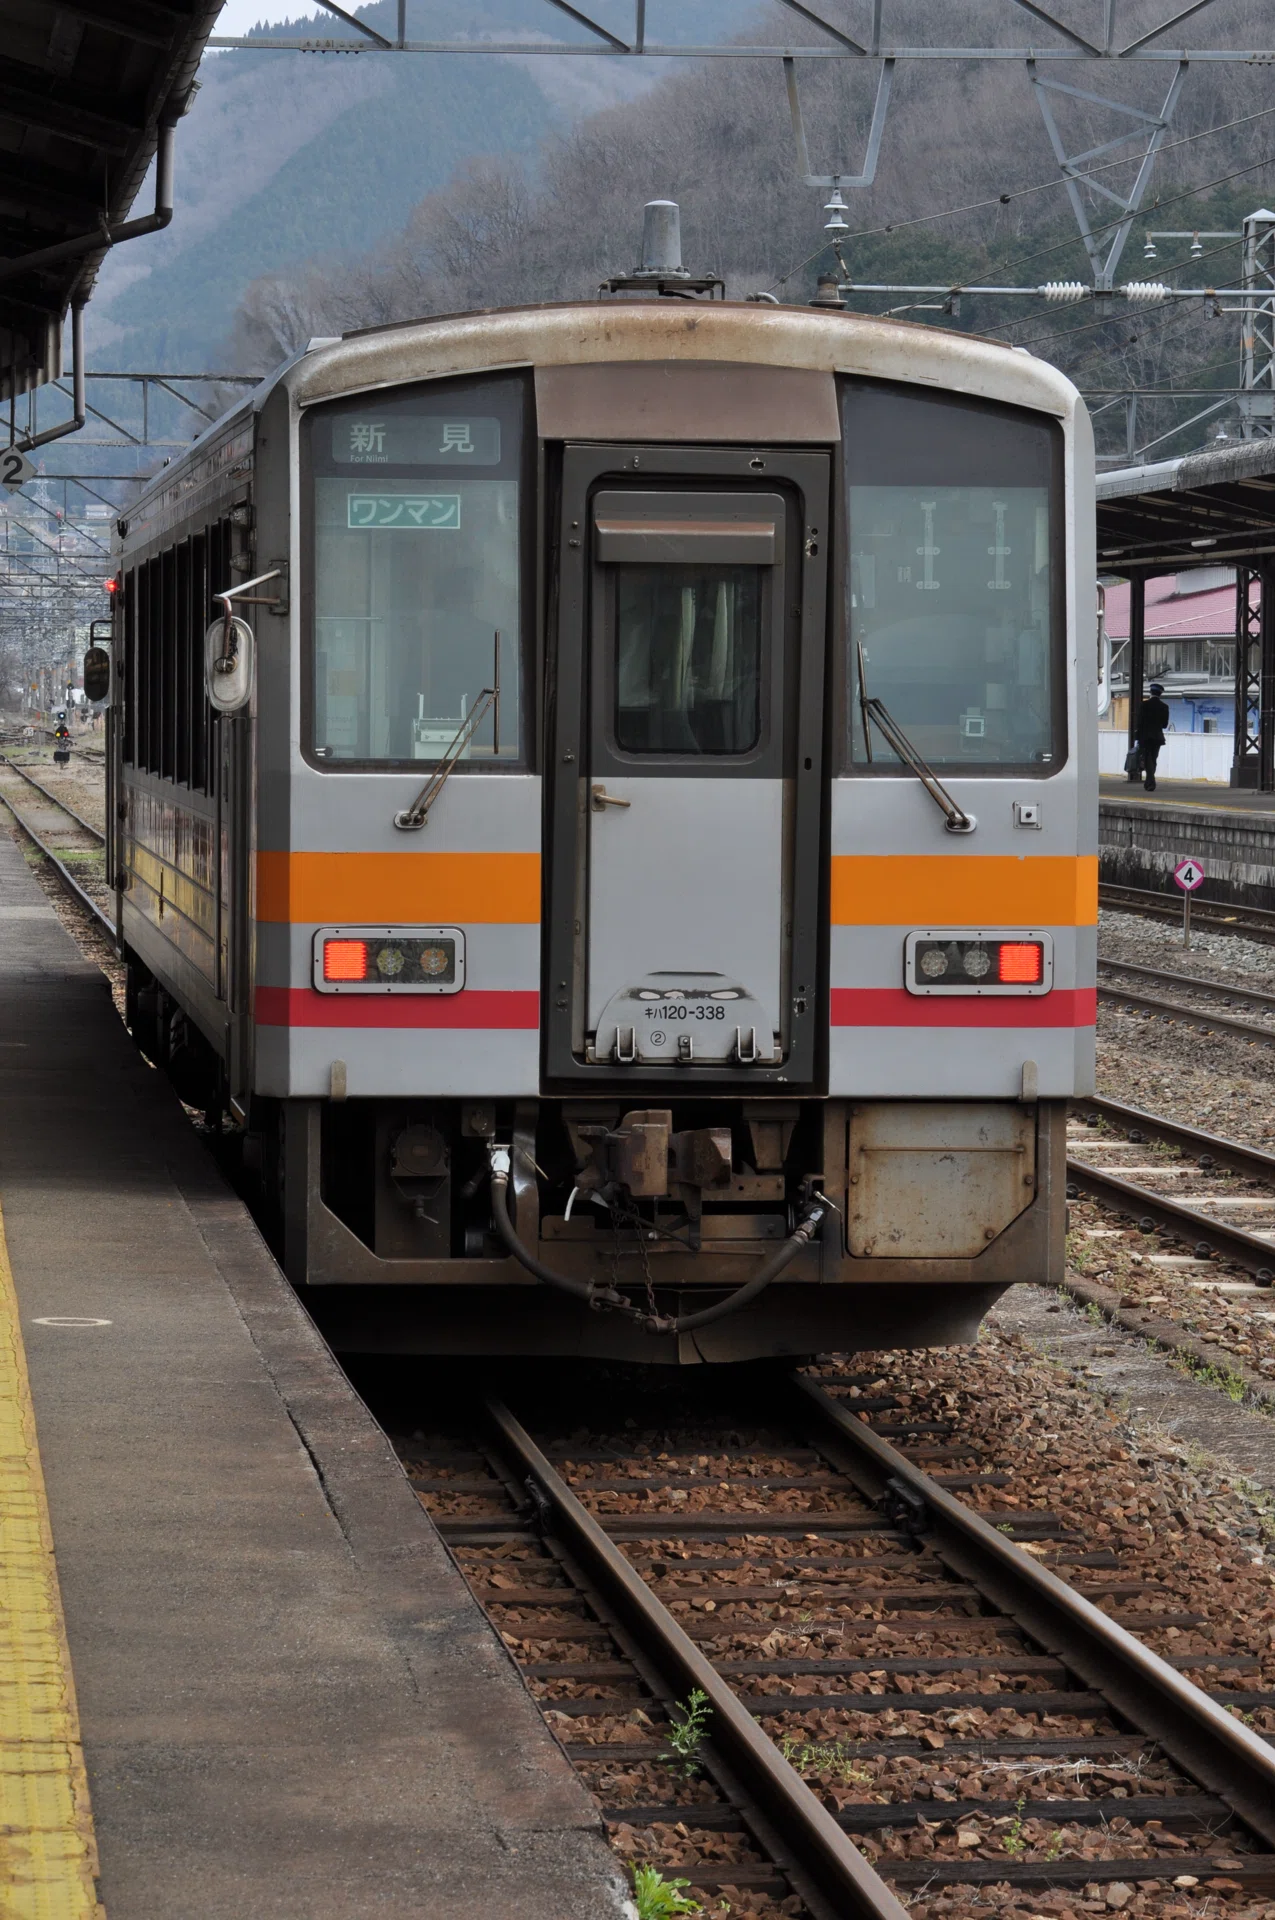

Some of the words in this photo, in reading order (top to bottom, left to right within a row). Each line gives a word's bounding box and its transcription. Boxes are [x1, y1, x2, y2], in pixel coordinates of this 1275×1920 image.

[350, 455, 363, 463] For
[366, 455, 389, 463] Niimi
[2, 455, 23, 484] 2
[352, 499, 456, 525] ワンマン
[1183, 867, 1194, 882] 4
